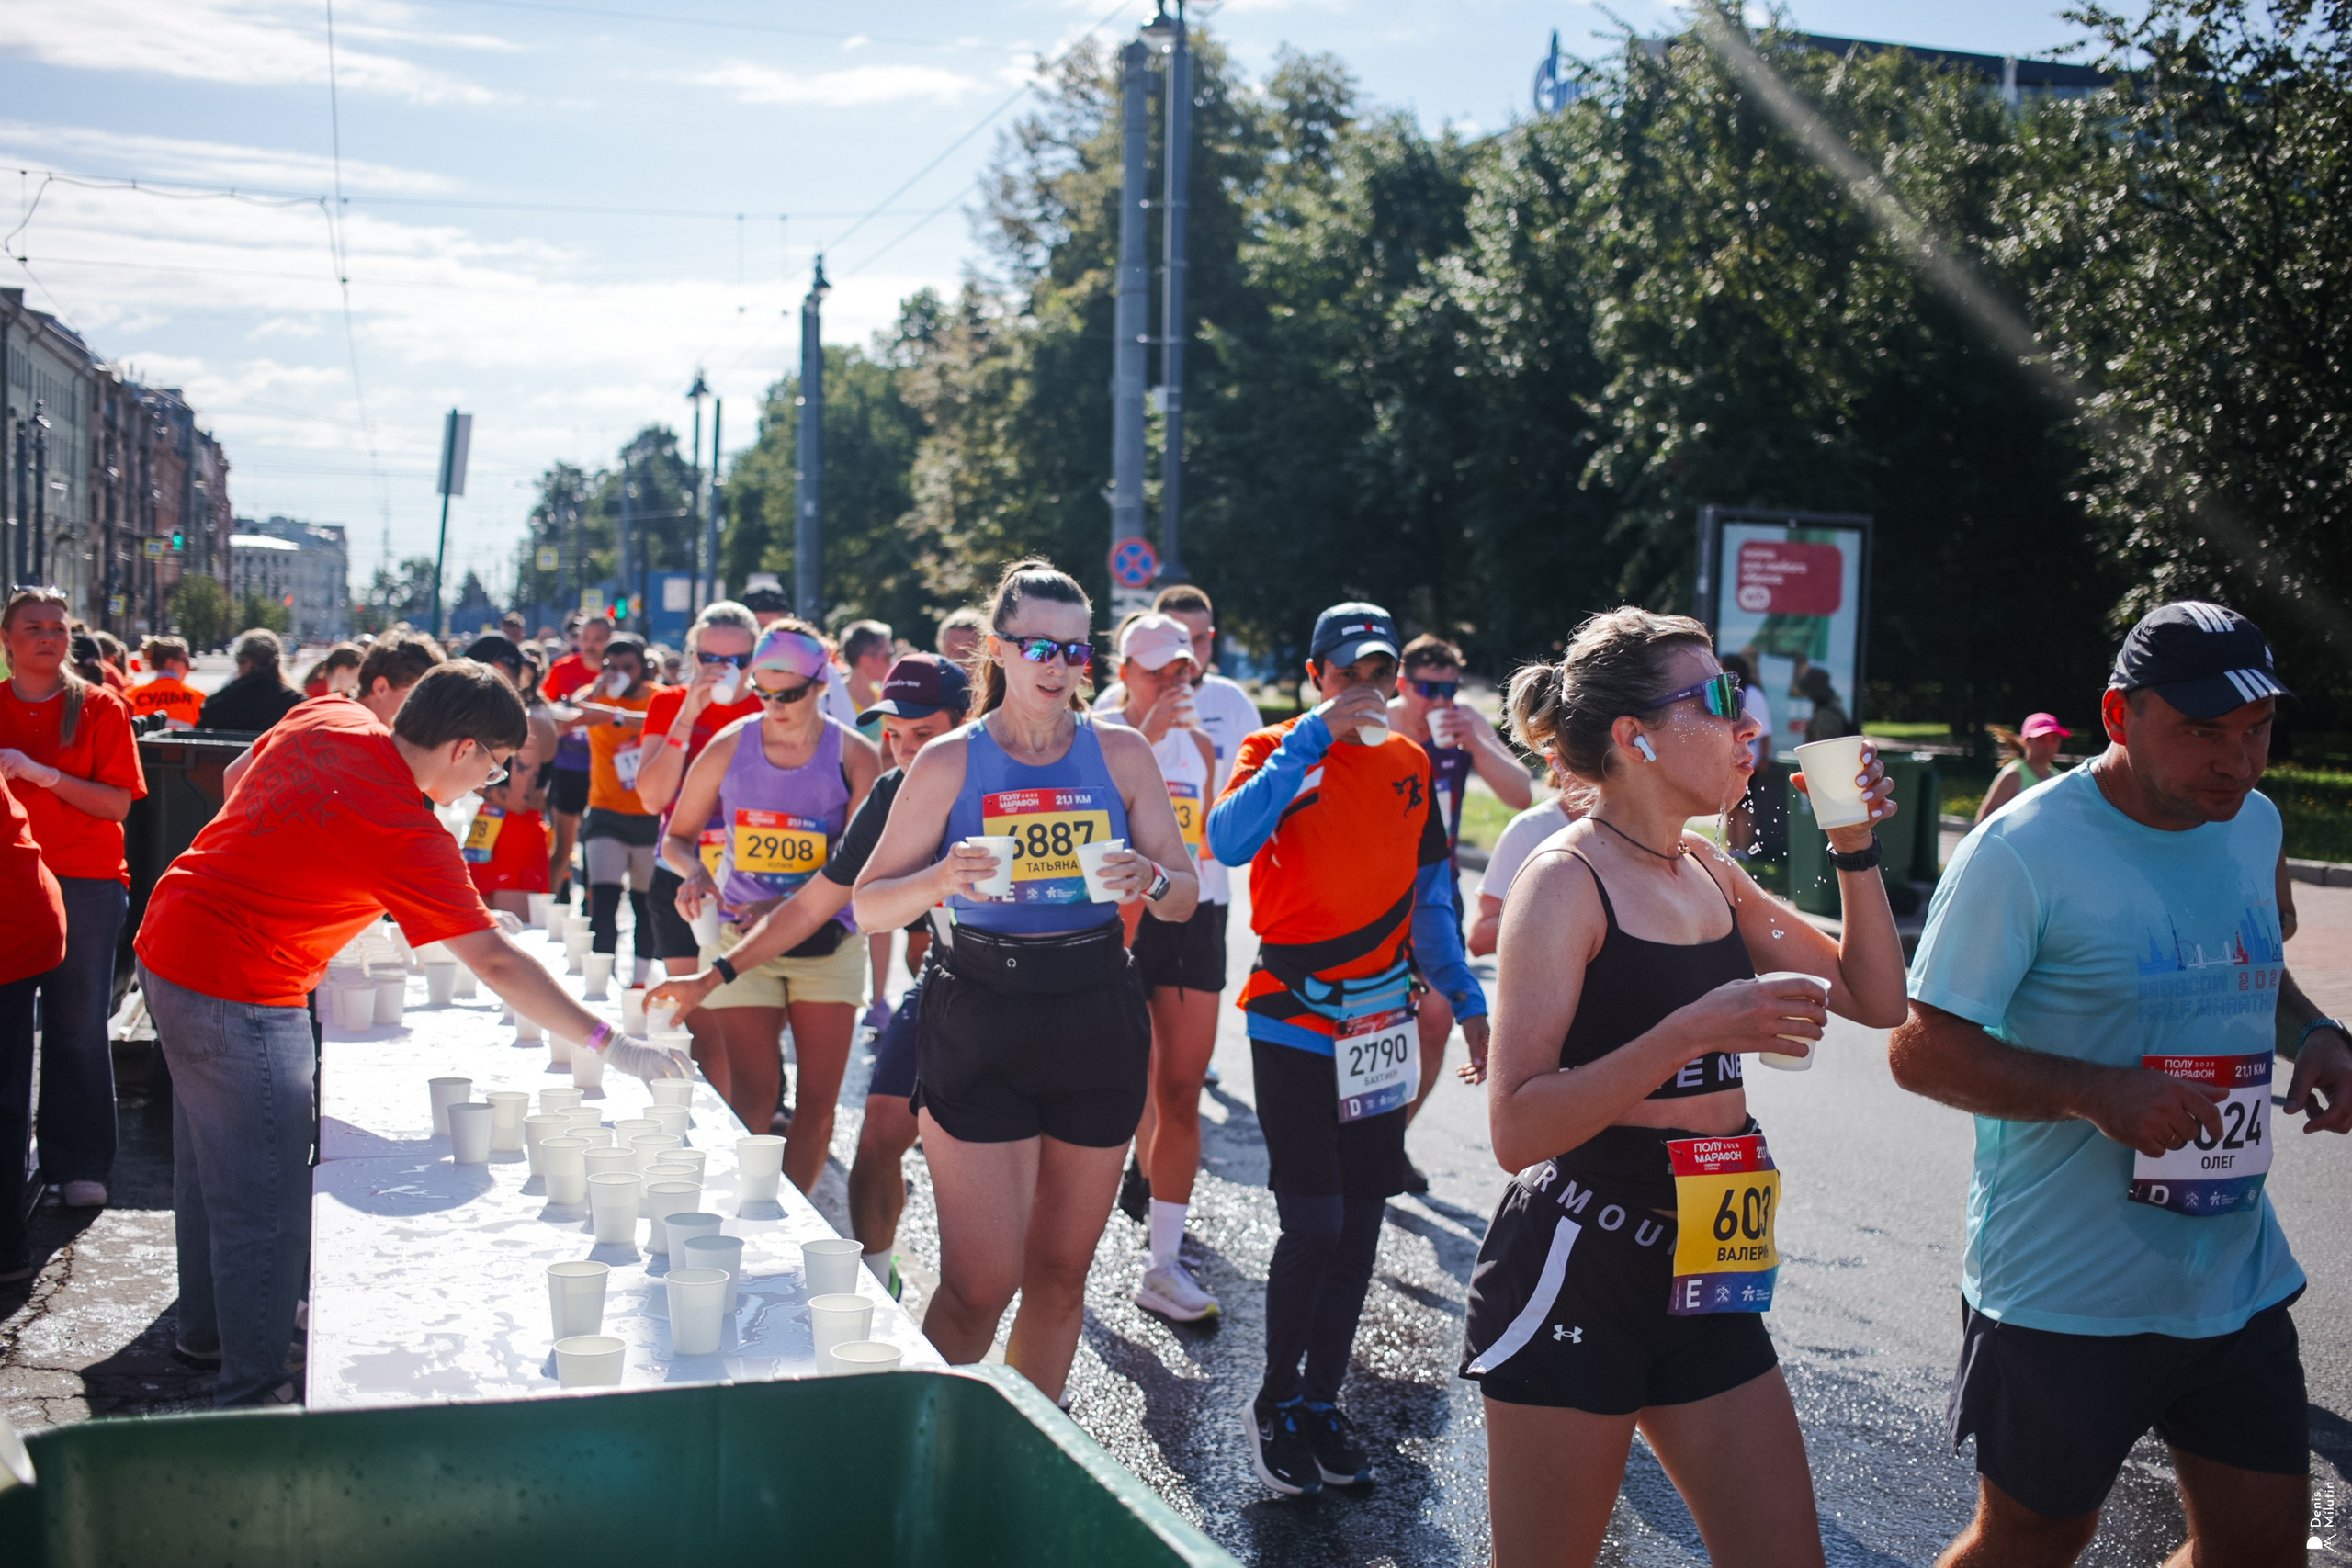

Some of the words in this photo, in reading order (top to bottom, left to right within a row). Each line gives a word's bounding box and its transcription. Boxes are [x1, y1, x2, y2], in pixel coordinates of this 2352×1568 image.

[135, 692, 193, 706] СУДЬЯ
[999, 793, 1021, 801] ПОЛУ
[1000, 799, 1039, 808] МАРАФОН
[1056, 795, 1073, 806] 21,1
[1173, 805, 1191, 828] 3
[748, 835, 814, 861] 2908
[1008, 820, 1094, 860] 6887
[1026, 860, 1079, 873] ТАТЬЯНА
[2238, 969, 2283, 991] 202
[1349, 1034, 1407, 1077] 2790
[2165, 1059, 2193, 1069] ПОЛУ
[2234, 1065, 2252, 1077] 21,1
[1364, 1069, 1398, 1086] БАХТИЕР
[1349, 1098, 1361, 1117] D
[1693, 1142, 1722, 1153] ПОЛУ
[1694, 1151, 1742, 1163] МАРАФОН
[2201, 1155, 2235, 1170] ОЛЕГ
[2148, 1185, 2169, 1204] D
[1519, 1165, 1677, 1255] RMOU
[1686, 1280, 1702, 1308] E
